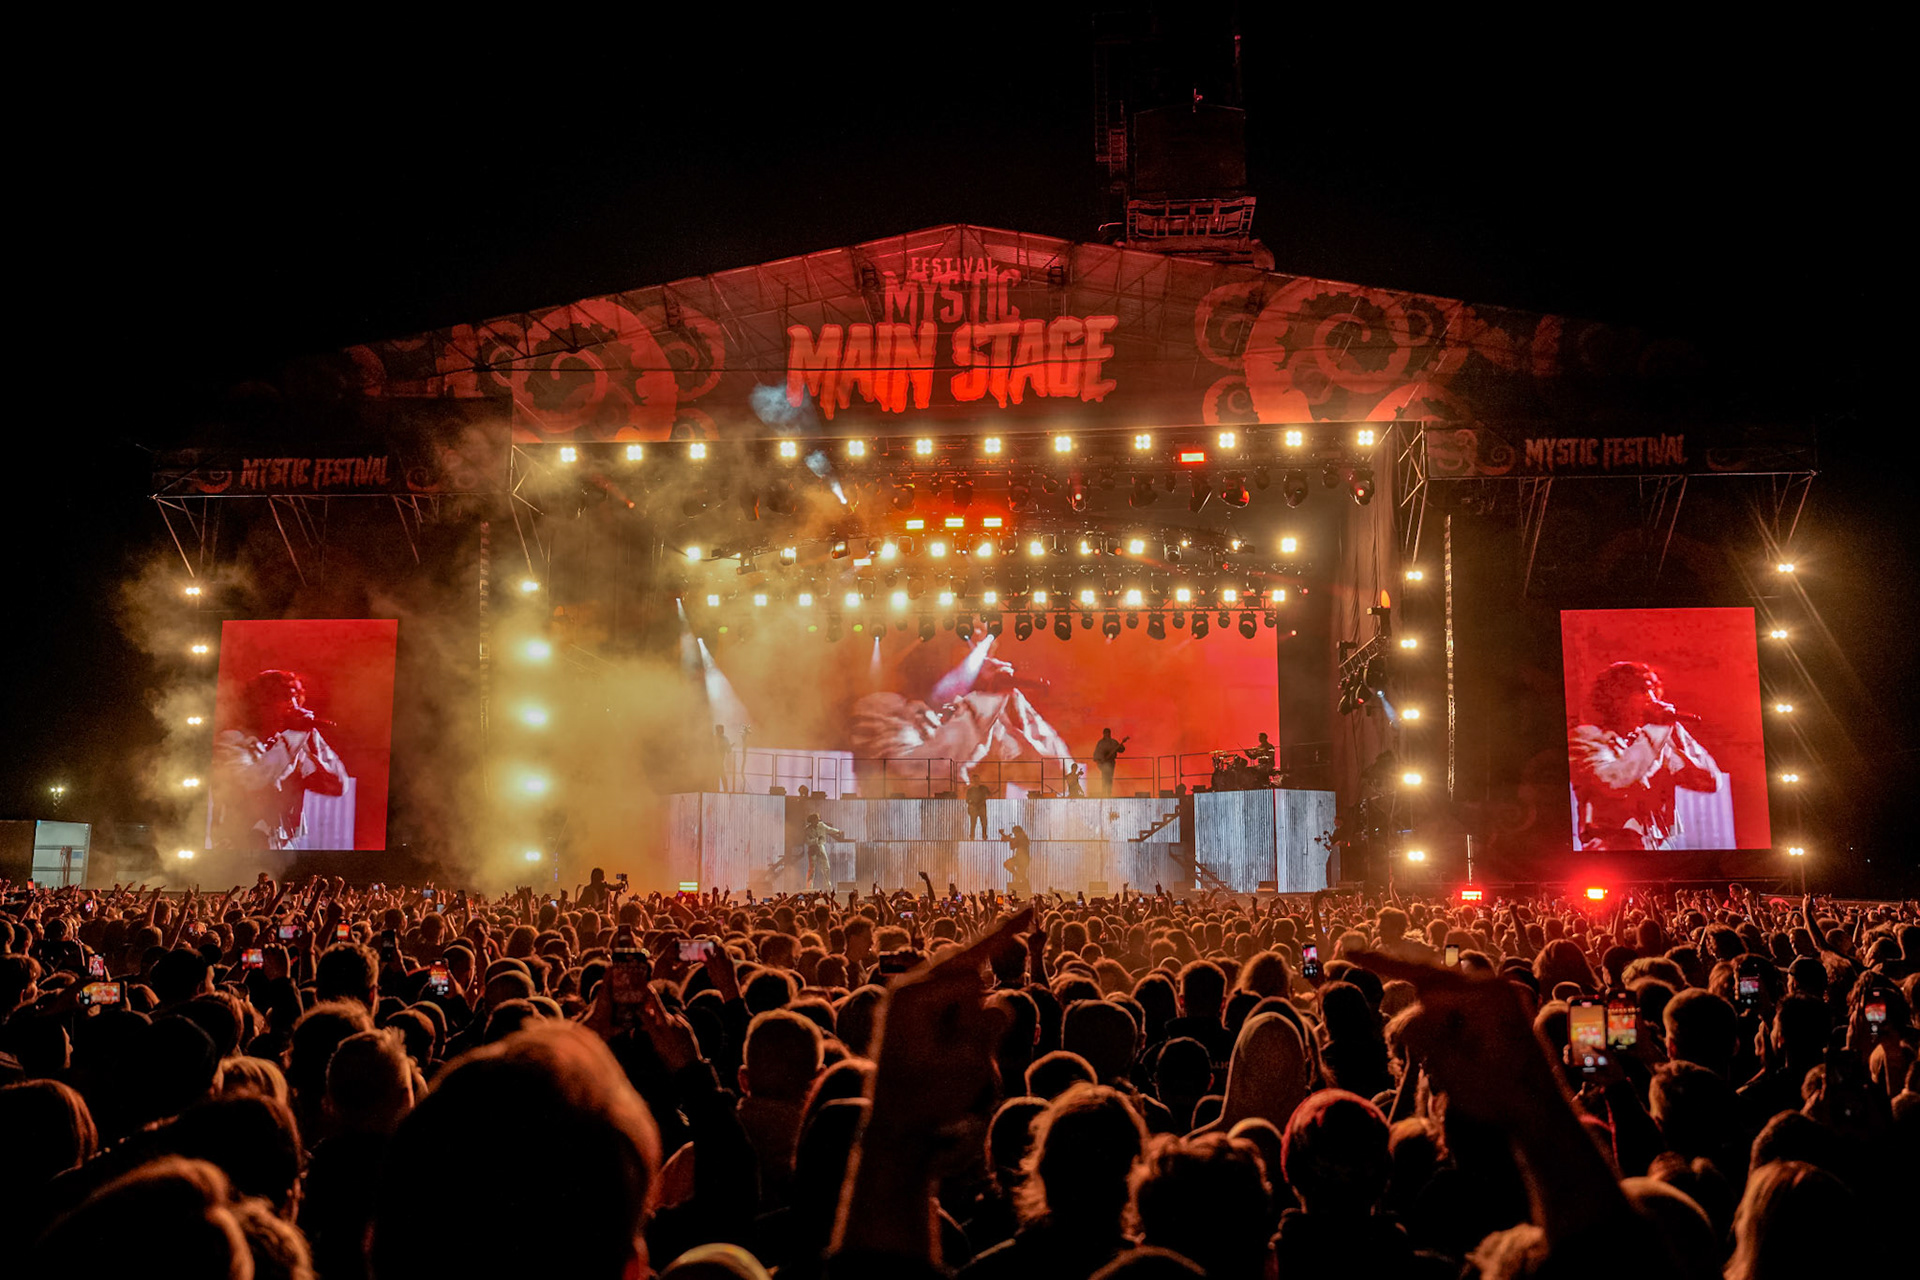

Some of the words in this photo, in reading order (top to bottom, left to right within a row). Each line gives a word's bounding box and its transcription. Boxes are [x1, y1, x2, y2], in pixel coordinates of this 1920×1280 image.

[910, 256, 999, 279] FESTIVAL
[883, 269, 1022, 328] MYSTIC
[786, 320, 938, 420] MAIN
[951, 315, 1118, 409] STAGE
[1525, 436, 1600, 471] MYSTIC
[1602, 432, 1688, 471] FESTIVAL
[239, 457, 312, 489] MYSTIC
[313, 455, 391, 491] FESTIVAL
